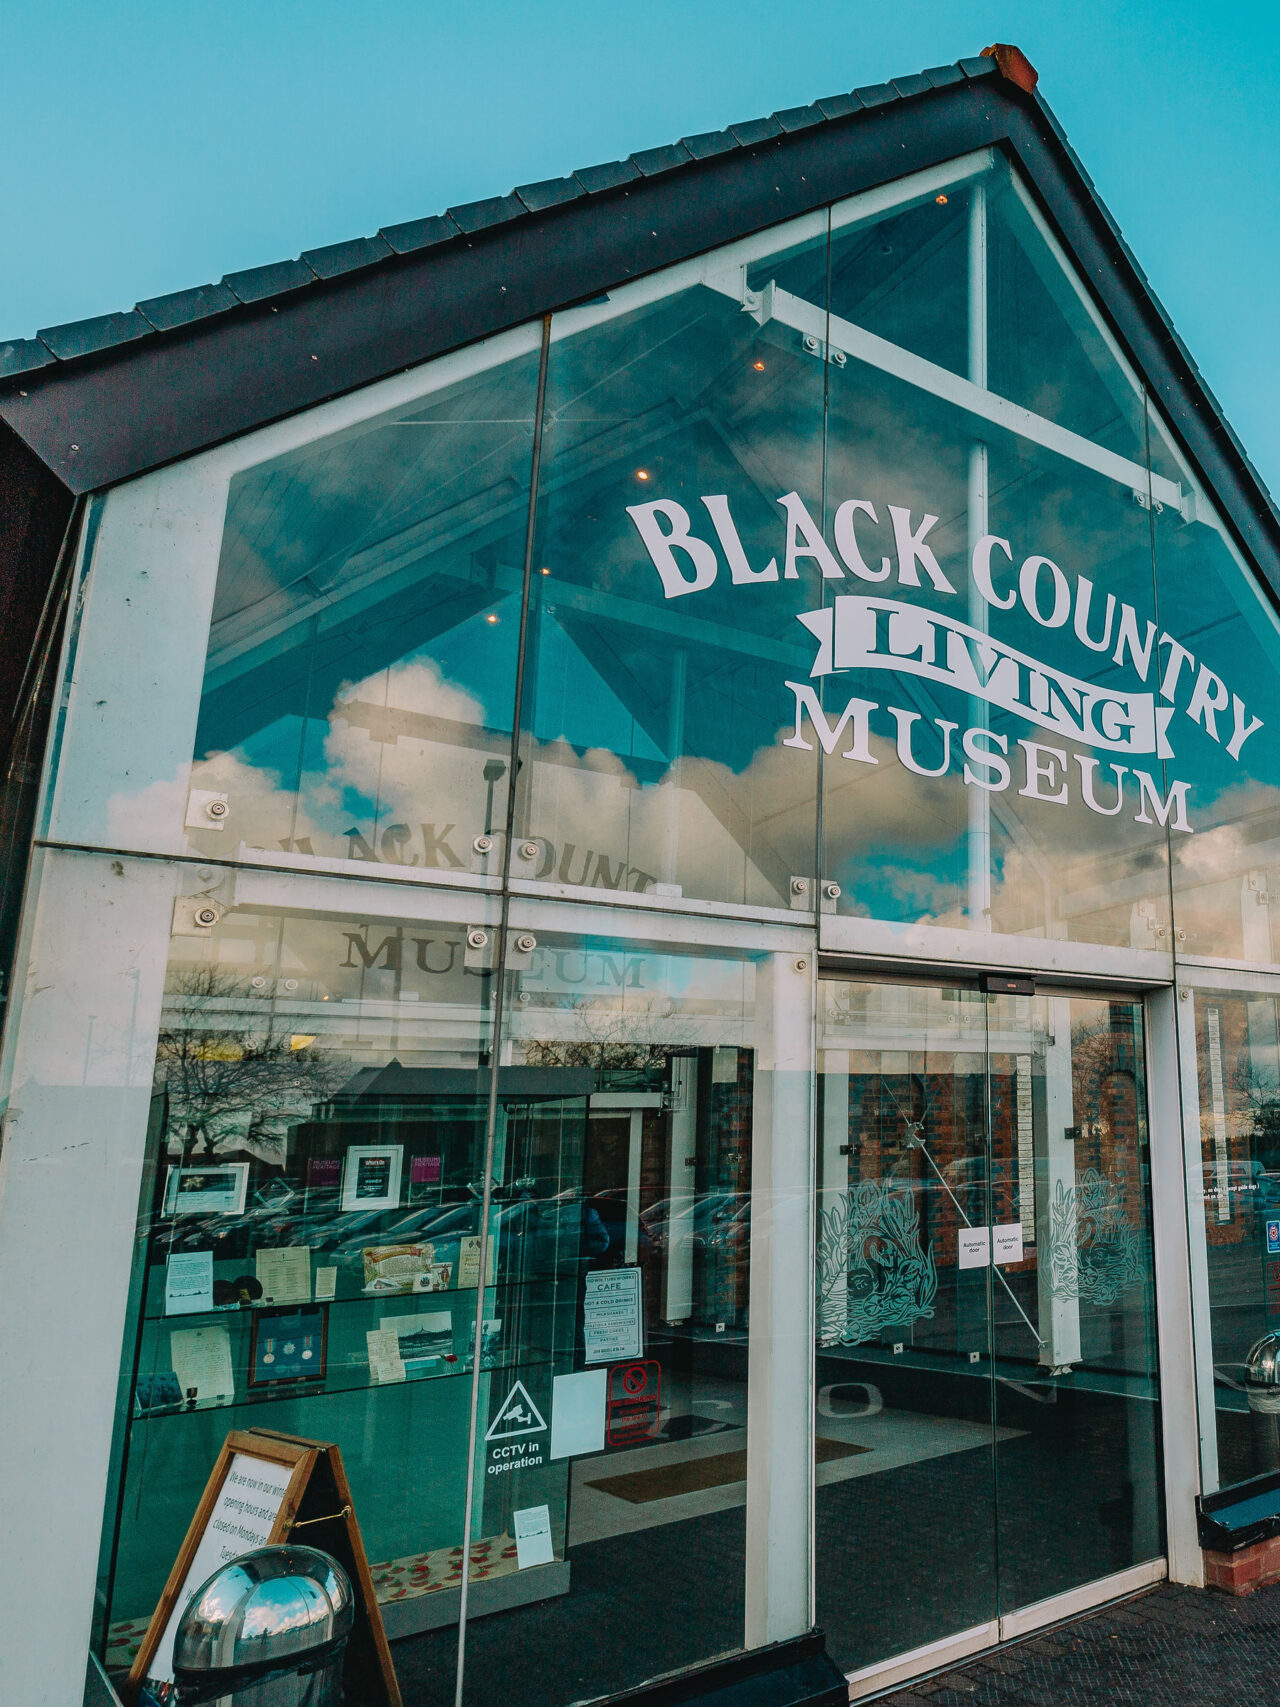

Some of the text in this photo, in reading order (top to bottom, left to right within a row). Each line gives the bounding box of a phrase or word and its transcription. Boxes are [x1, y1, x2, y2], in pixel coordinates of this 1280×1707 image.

[626, 491, 1265, 763] BLACK COUNTRY
[866, 606, 1136, 746] LIVING
[782, 680, 1195, 834] MUSEUM
[339, 931, 647, 990] MUEUM
[597, 1283, 622, 1291] CAFE
[492, 1442, 539, 1459] CCTV in
[487, 1456, 543, 1475] operation
[246, 1478, 258, 1489] now
[263, 1483, 273, 1493] our
[271, 1484, 286, 1498] winte
[224, 1496, 244, 1515] opening
[244, 1500, 259, 1516] hours
[258, 1506, 270, 1520] and
[212, 1518, 231, 1533] closed
[229, 1525, 238, 1535] on
[238, 1525, 259, 1546] Mondays
